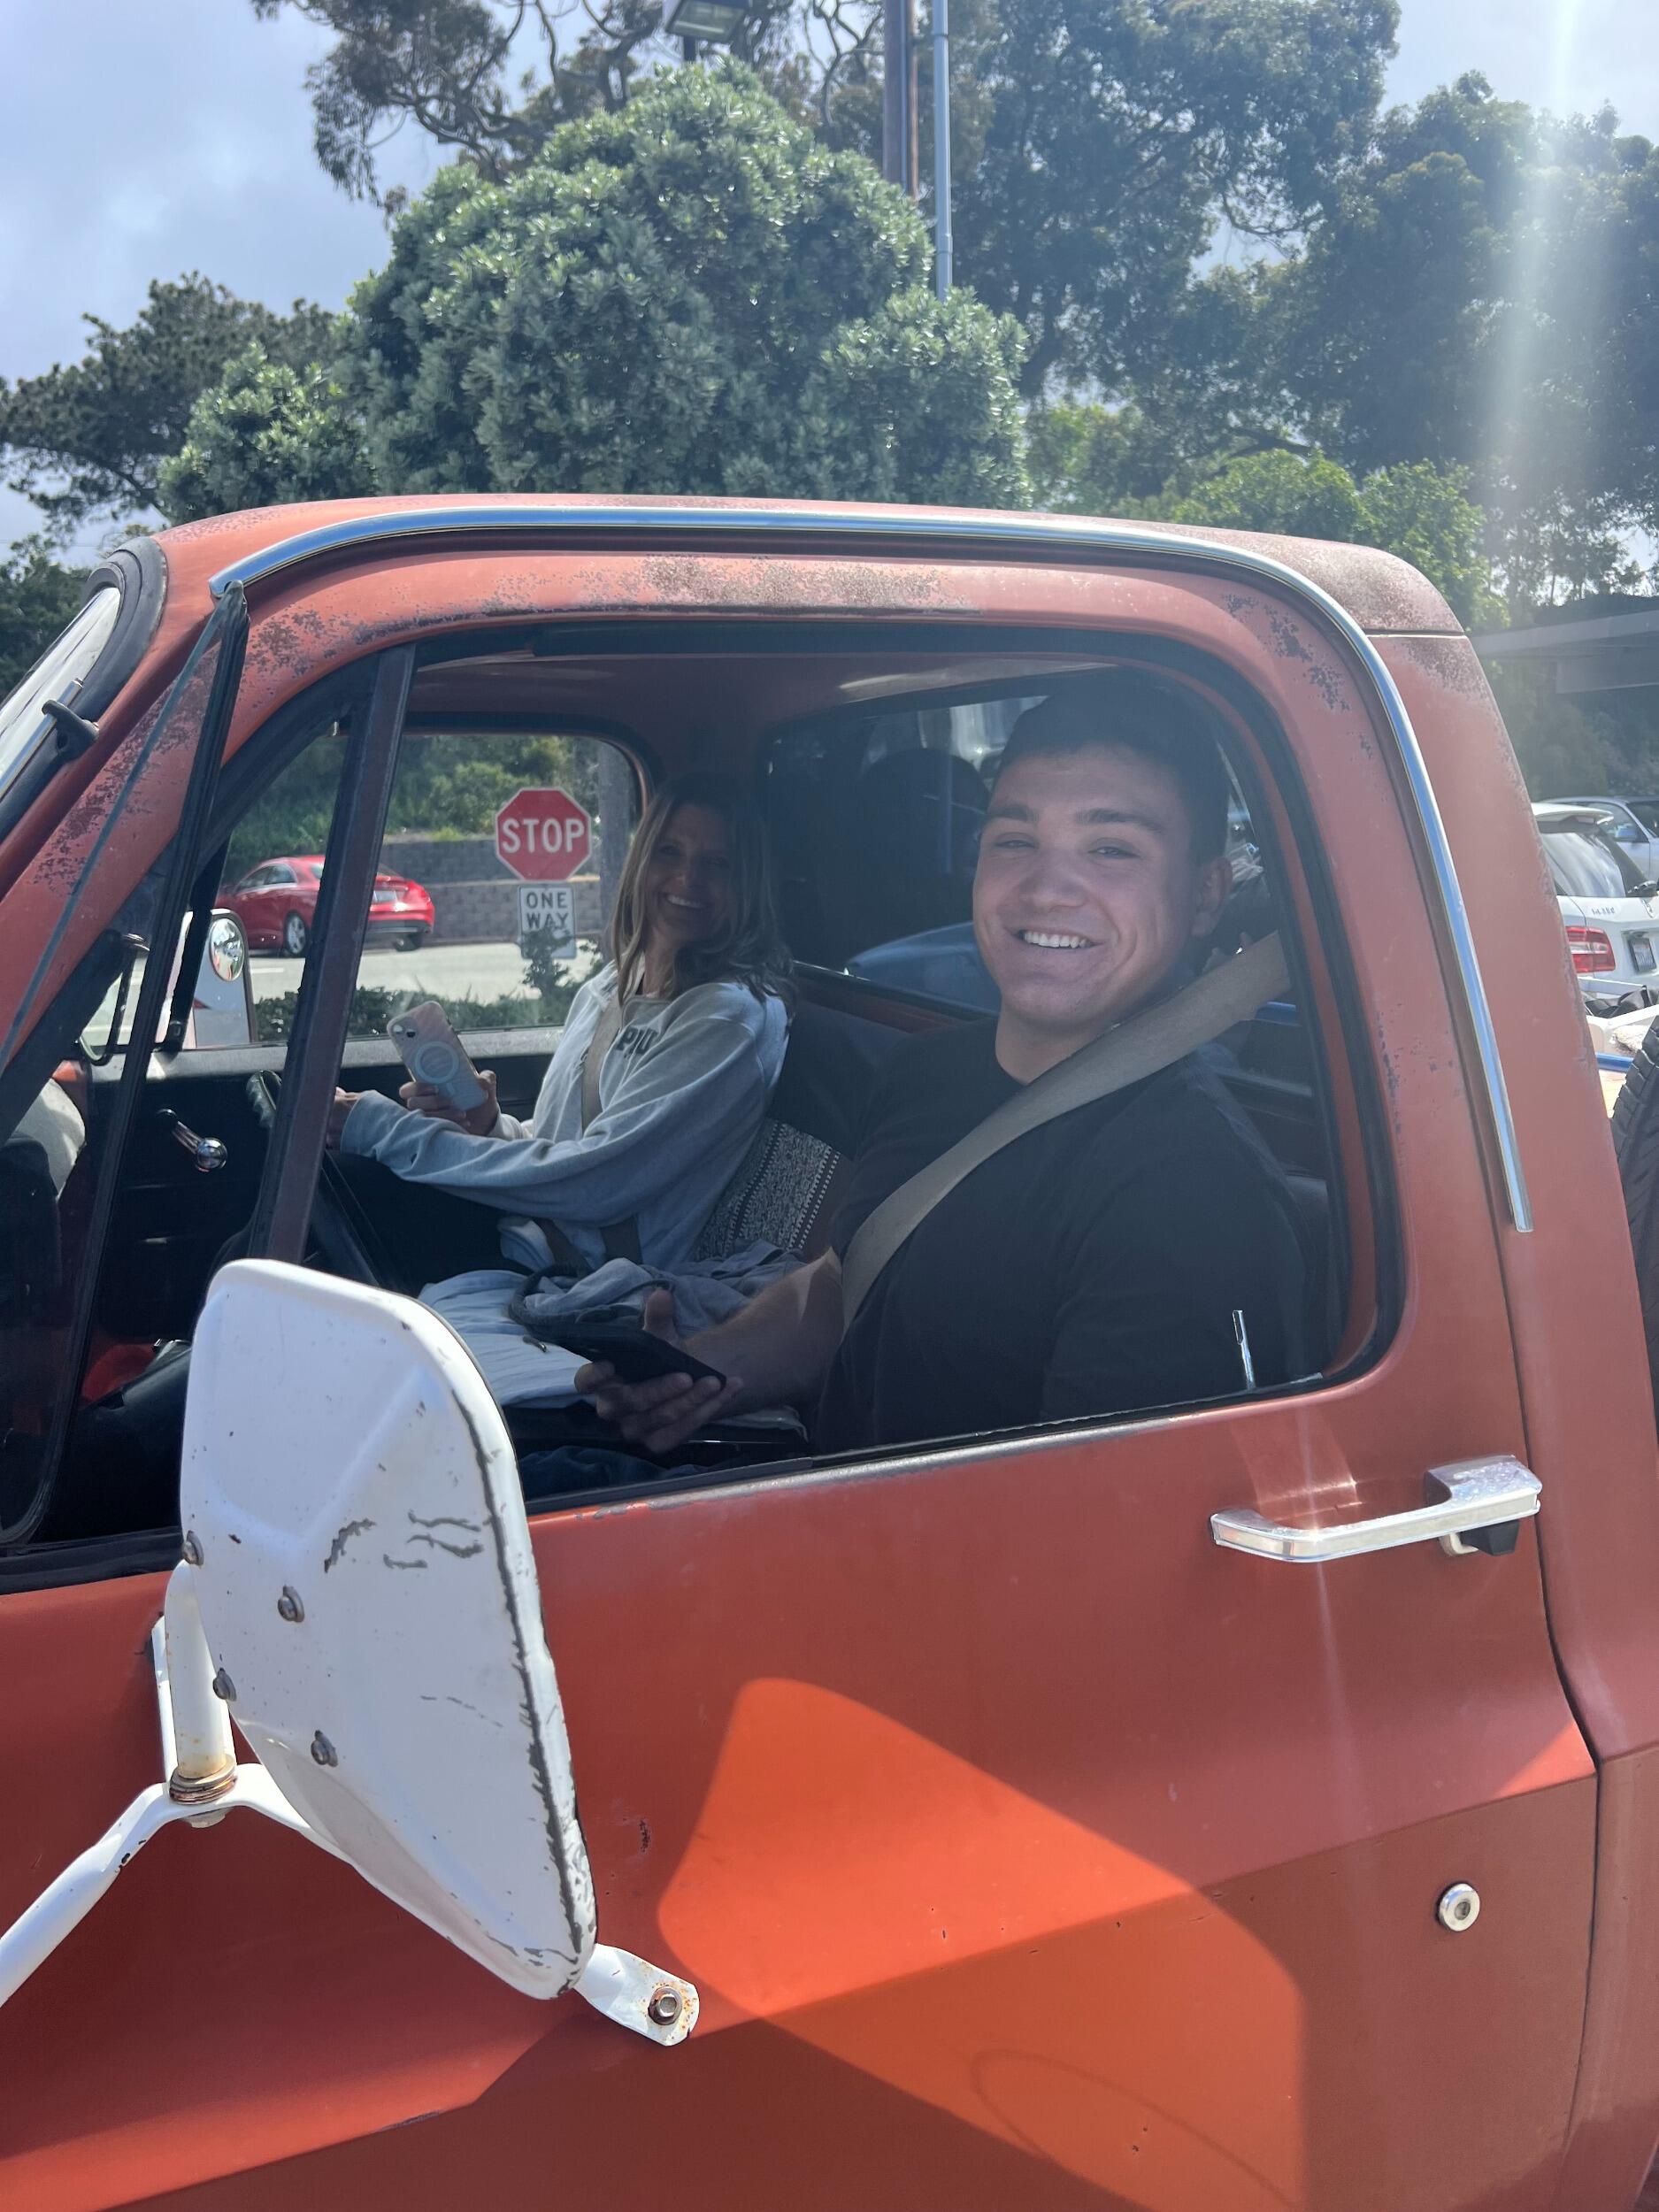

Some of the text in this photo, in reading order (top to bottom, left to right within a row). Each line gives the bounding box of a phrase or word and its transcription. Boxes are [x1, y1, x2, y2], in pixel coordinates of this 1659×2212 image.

[502, 818, 585, 854] STOP
[526, 892, 567, 909] ONE
[526, 912, 569, 929] WAY
